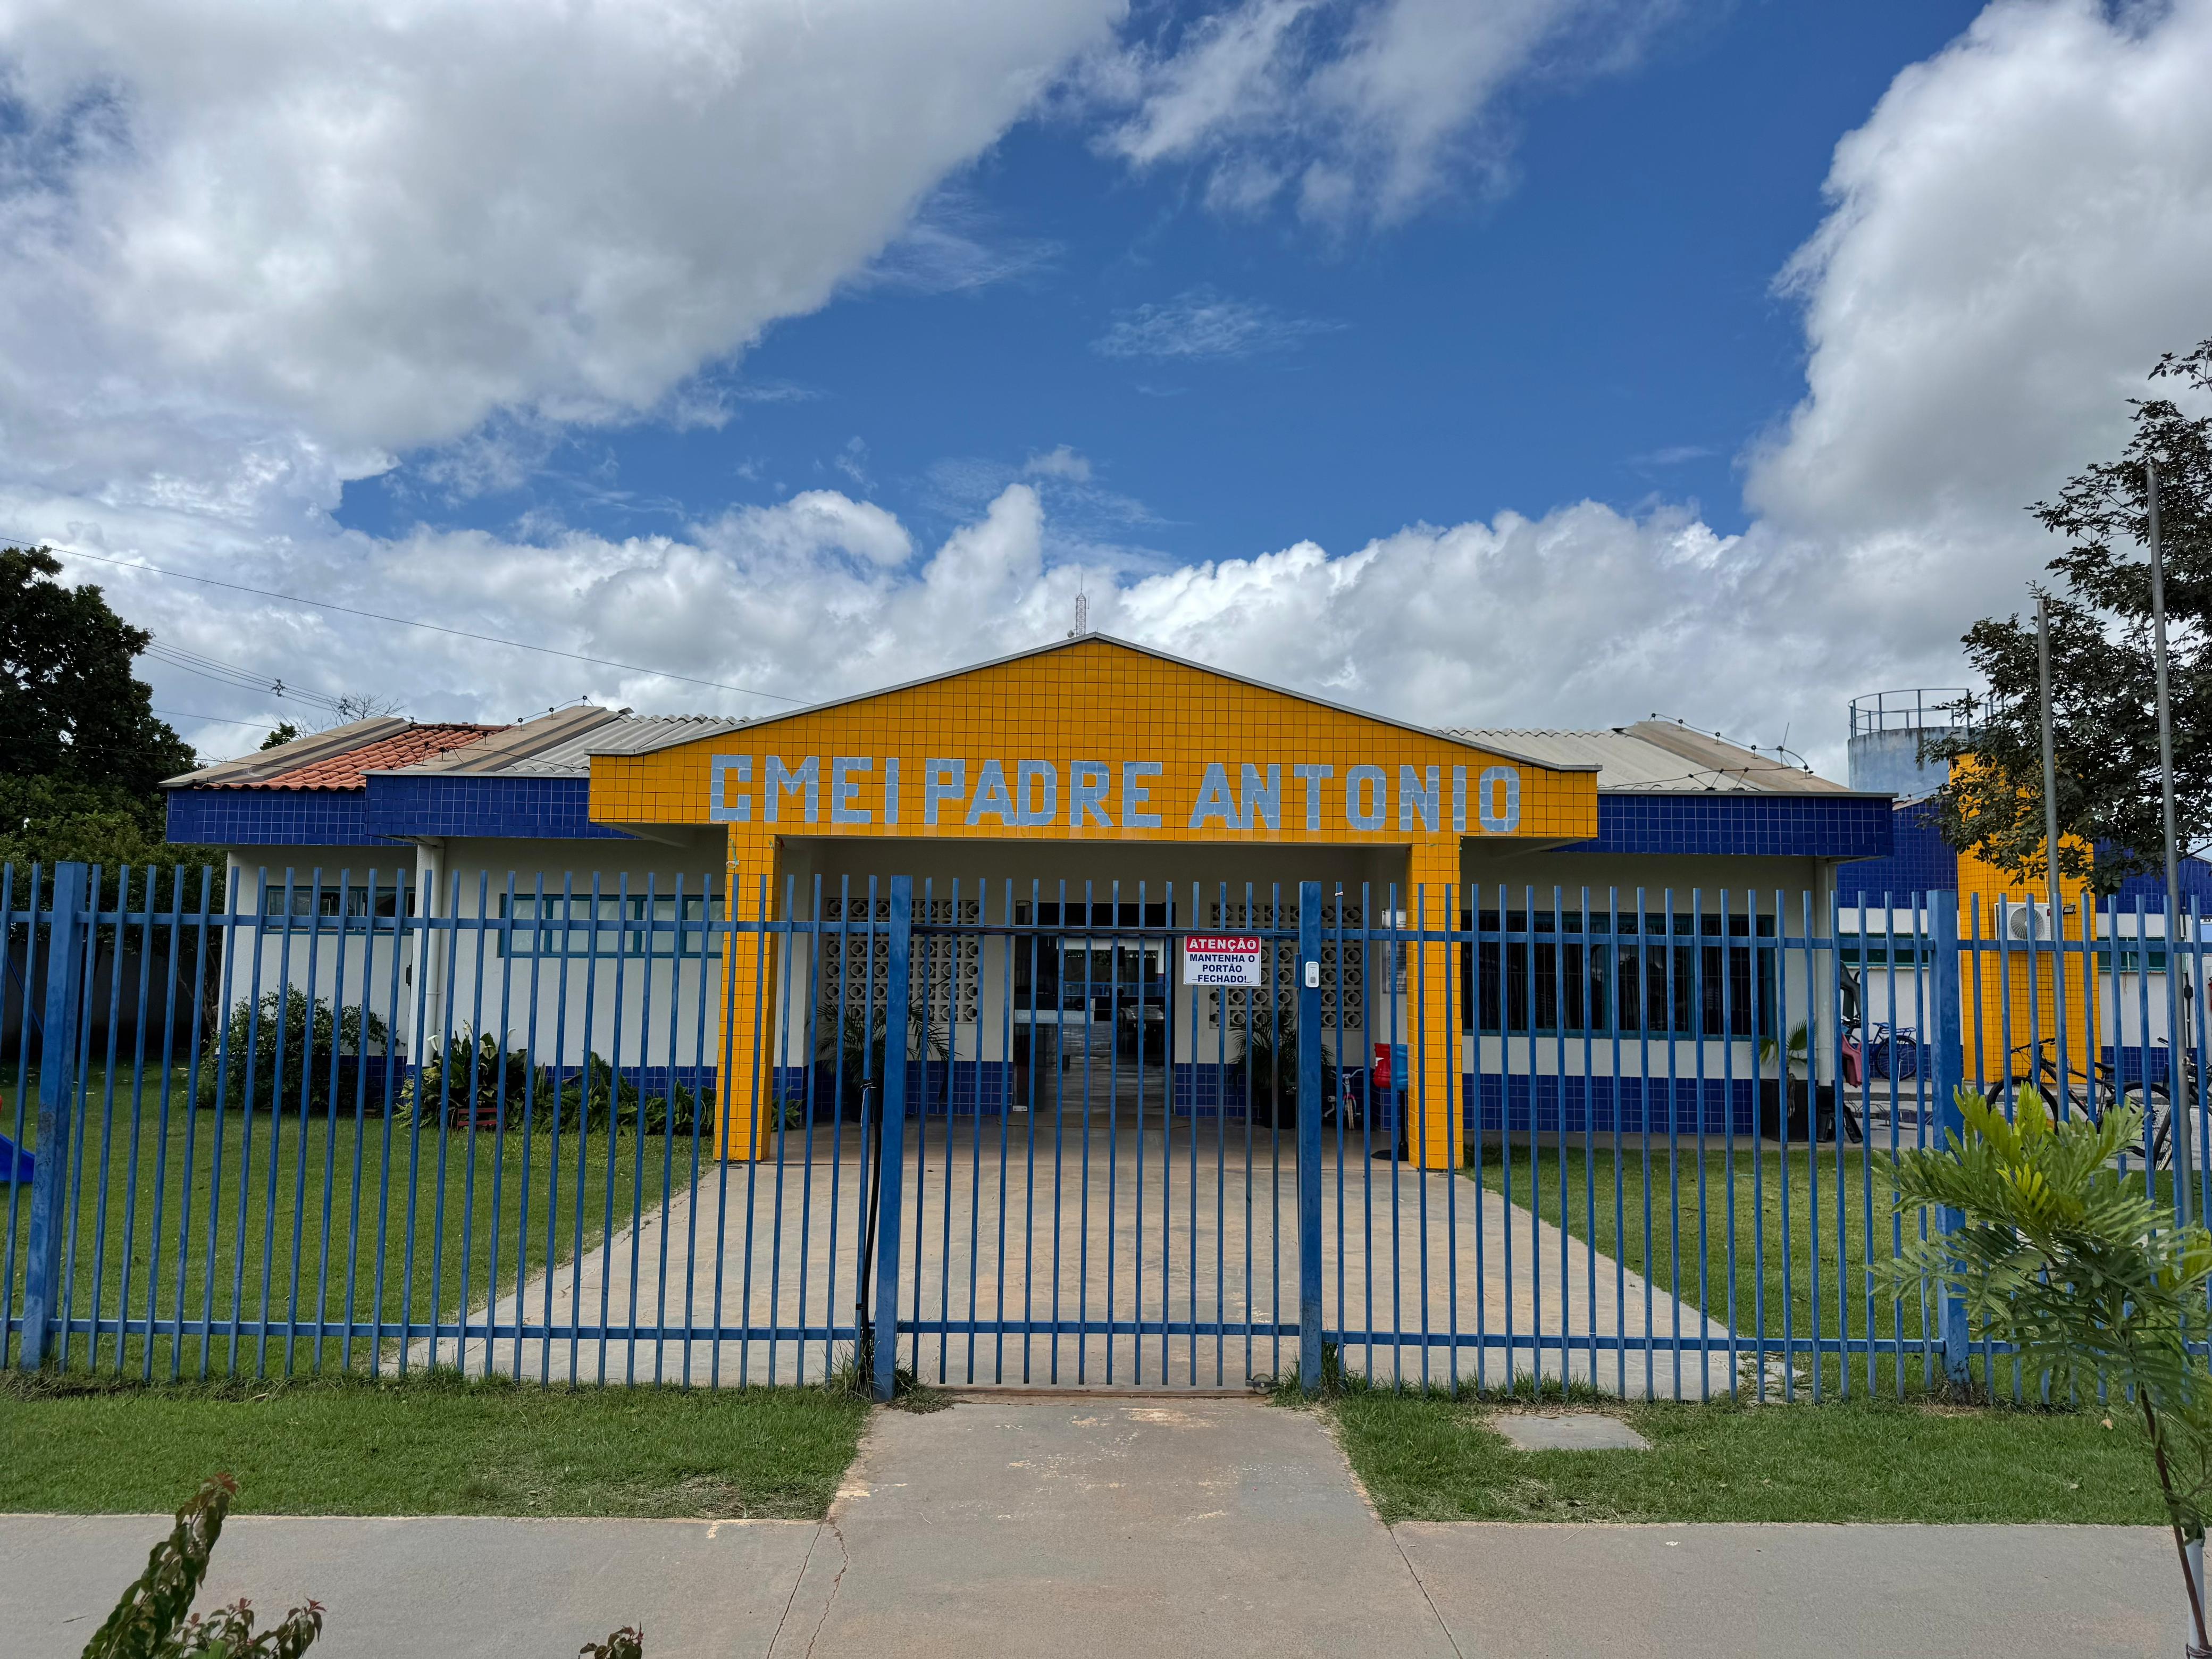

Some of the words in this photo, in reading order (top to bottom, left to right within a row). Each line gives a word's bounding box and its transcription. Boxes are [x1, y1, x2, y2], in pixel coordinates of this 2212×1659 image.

[710, 754, 899, 823] CMEI
[924, 758, 1163, 826] PADRE
[1188, 763, 1520, 832] ANTONIO
[1189, 937, 1256, 952] ATENÇÃO
[1189, 954, 1245, 962] MANTENHA
[1202, 963, 1242, 973] PORTÃO
[1197, 975, 1247, 983] FECHADO!
